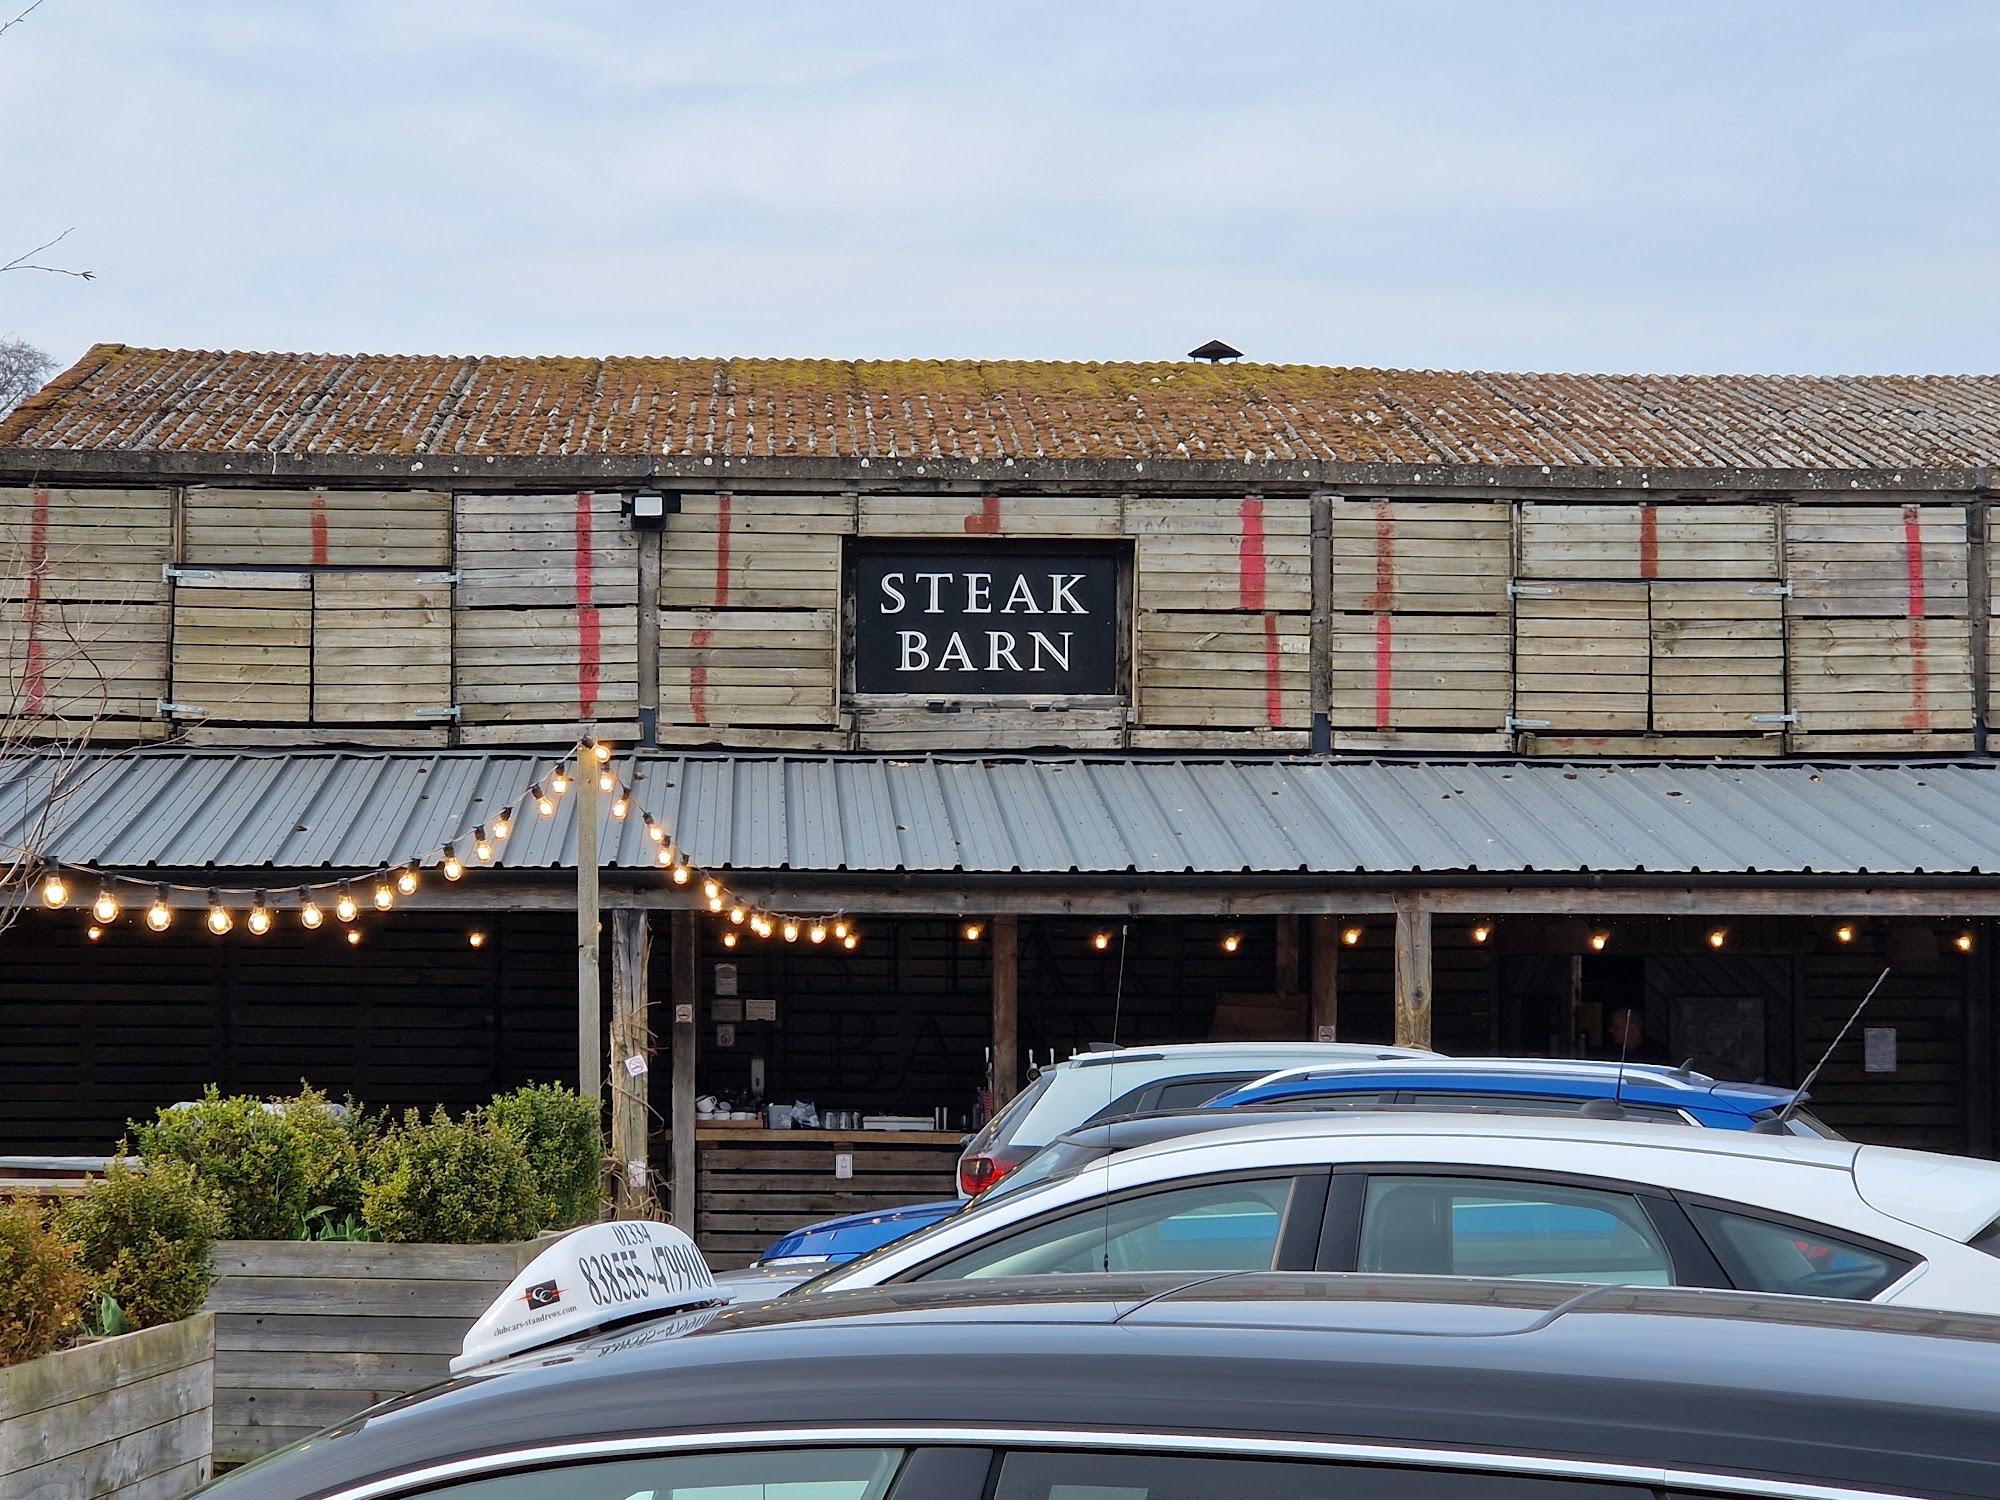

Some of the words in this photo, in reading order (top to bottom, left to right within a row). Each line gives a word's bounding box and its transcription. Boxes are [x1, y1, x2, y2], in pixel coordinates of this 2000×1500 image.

[880, 572, 1090, 614] STEAK
[894, 630, 1075, 672] BARN
[611, 1222, 653, 1247] 01334
[493, 1305, 578, 1337] clubcars-standrews.com
